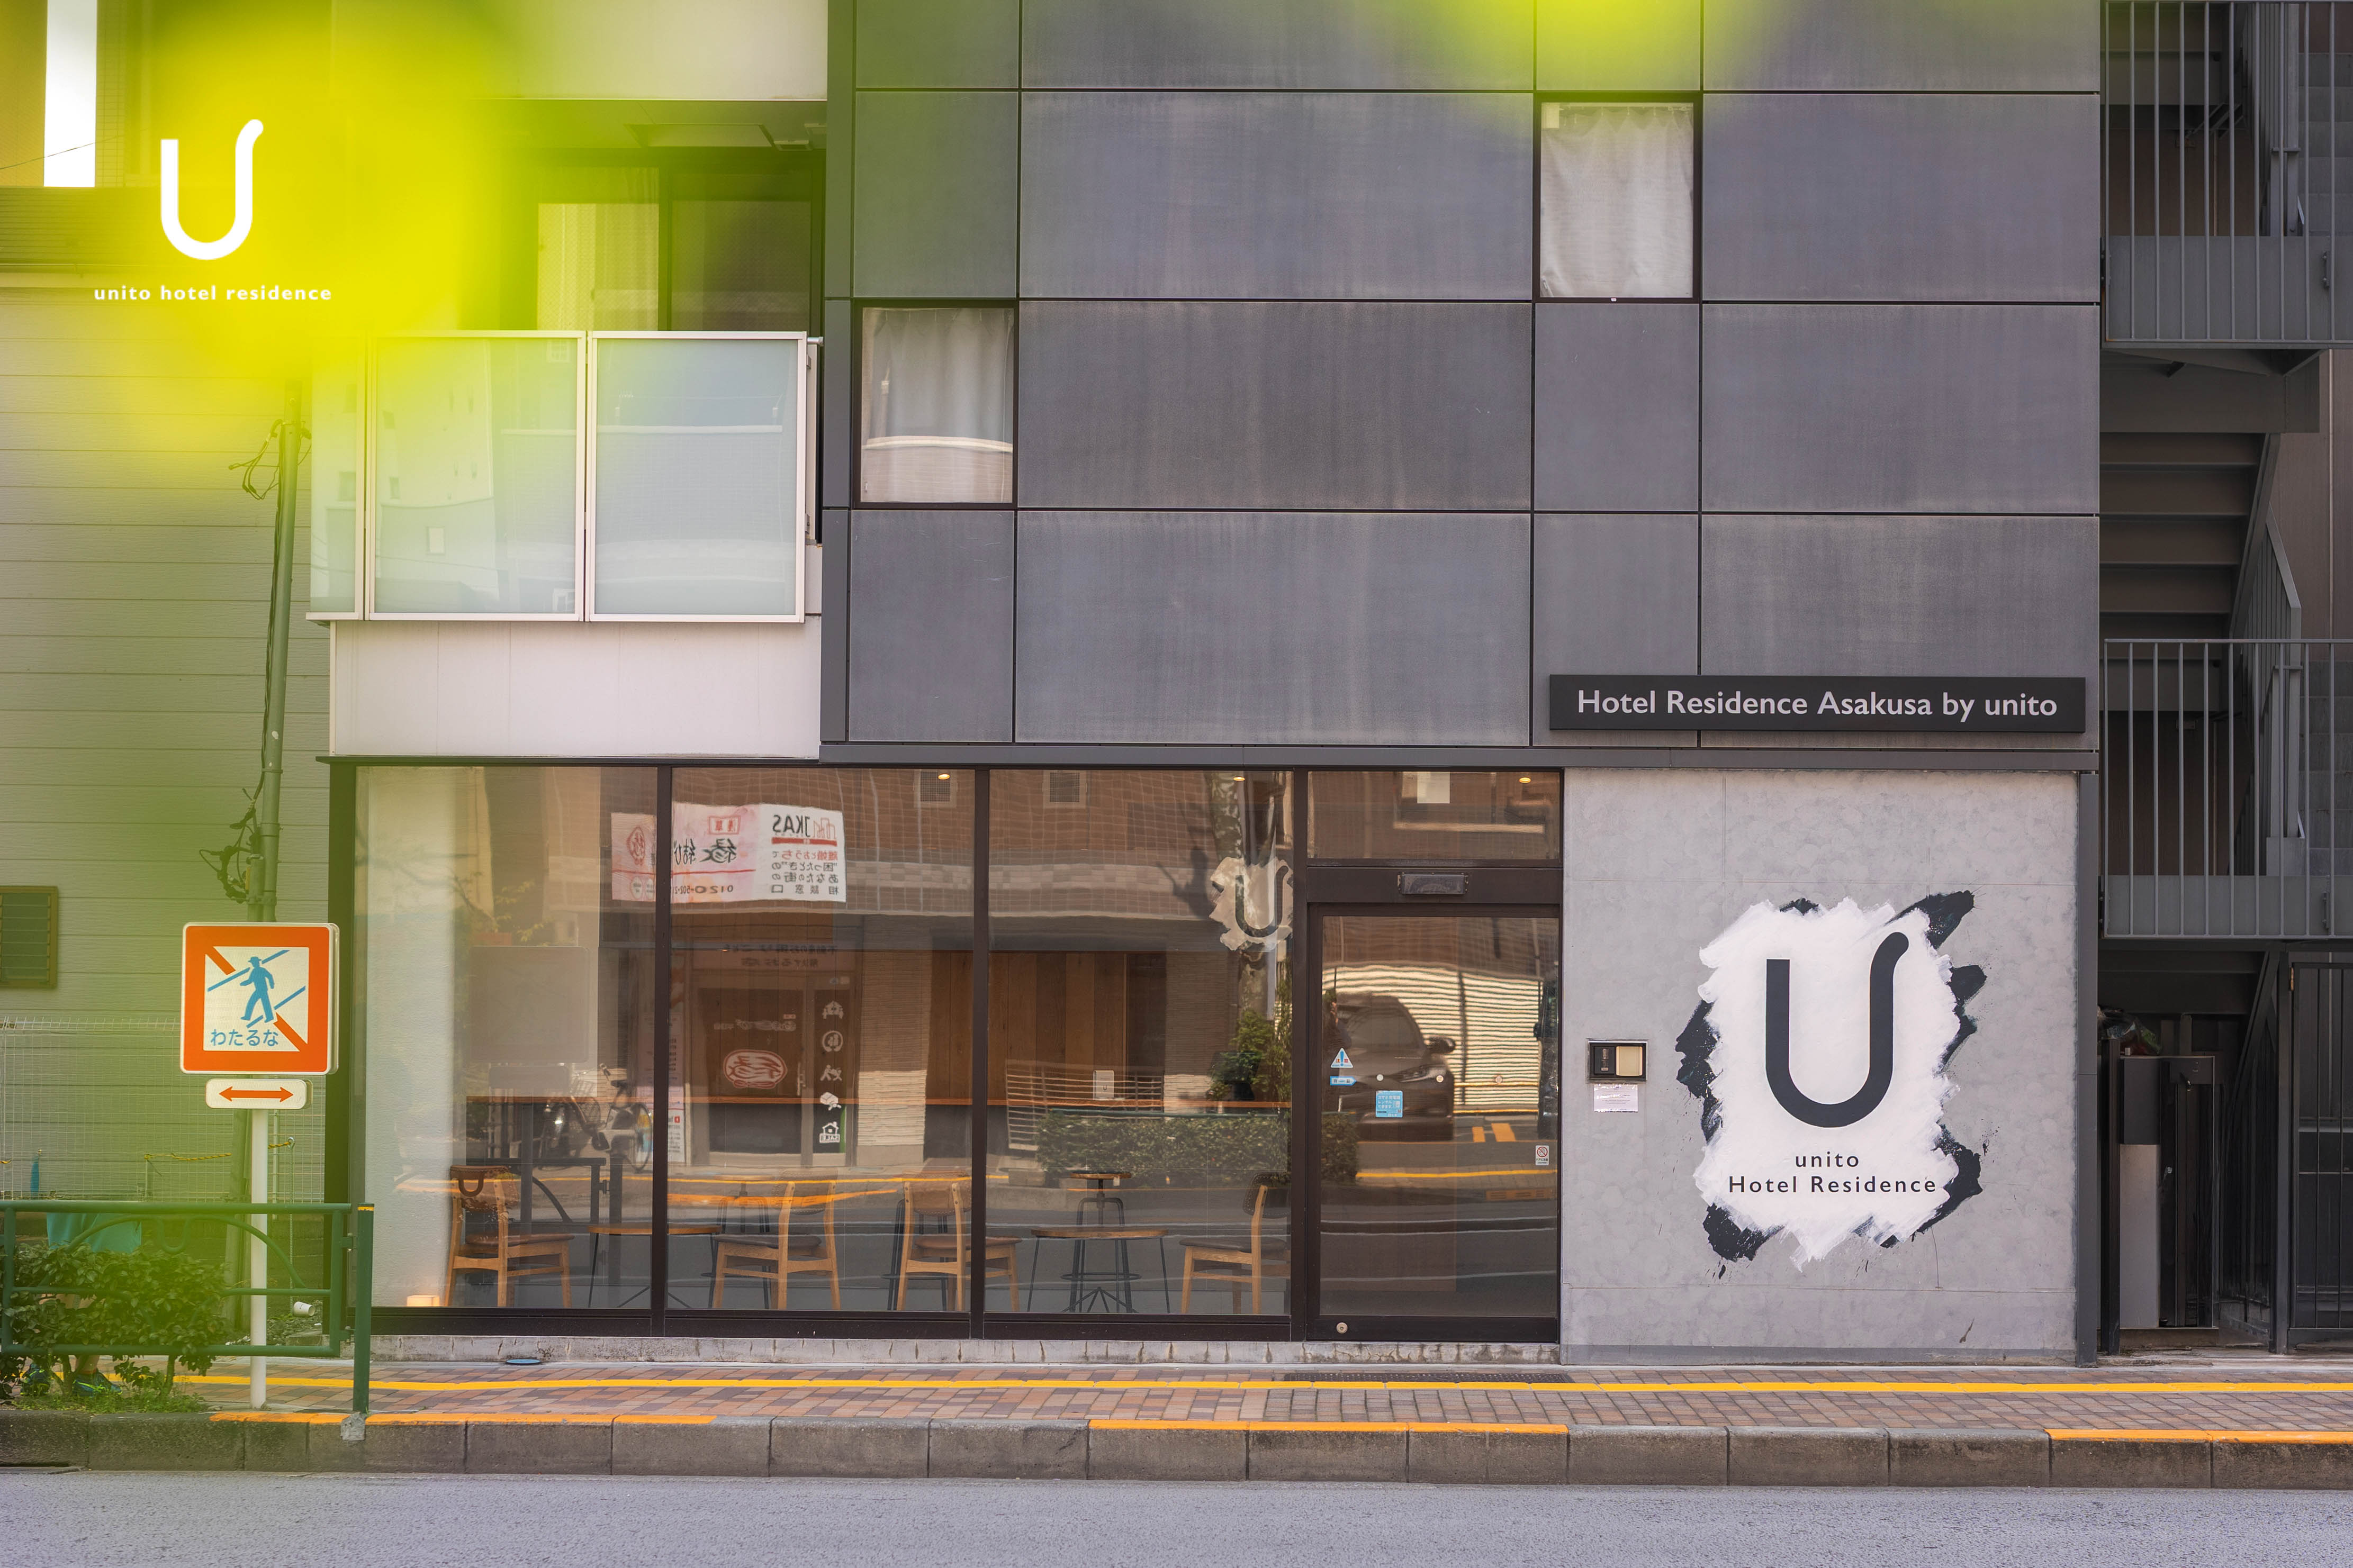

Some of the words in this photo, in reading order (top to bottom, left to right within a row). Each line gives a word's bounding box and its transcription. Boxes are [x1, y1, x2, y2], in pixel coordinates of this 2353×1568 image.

[1578, 690, 1655, 713] Hotel
[1667, 690, 1808, 714] Residence
[1817, 691, 1933, 715] Asakusa
[1943, 692, 1975, 722] by
[1985, 693, 2058, 716] unito
[211, 1029, 278, 1046] わたるな
[1796, 1151, 1859, 1167] unito
[1729, 1176, 1797, 1193] Hotel
[1811, 1175, 1936, 1193] Residence
